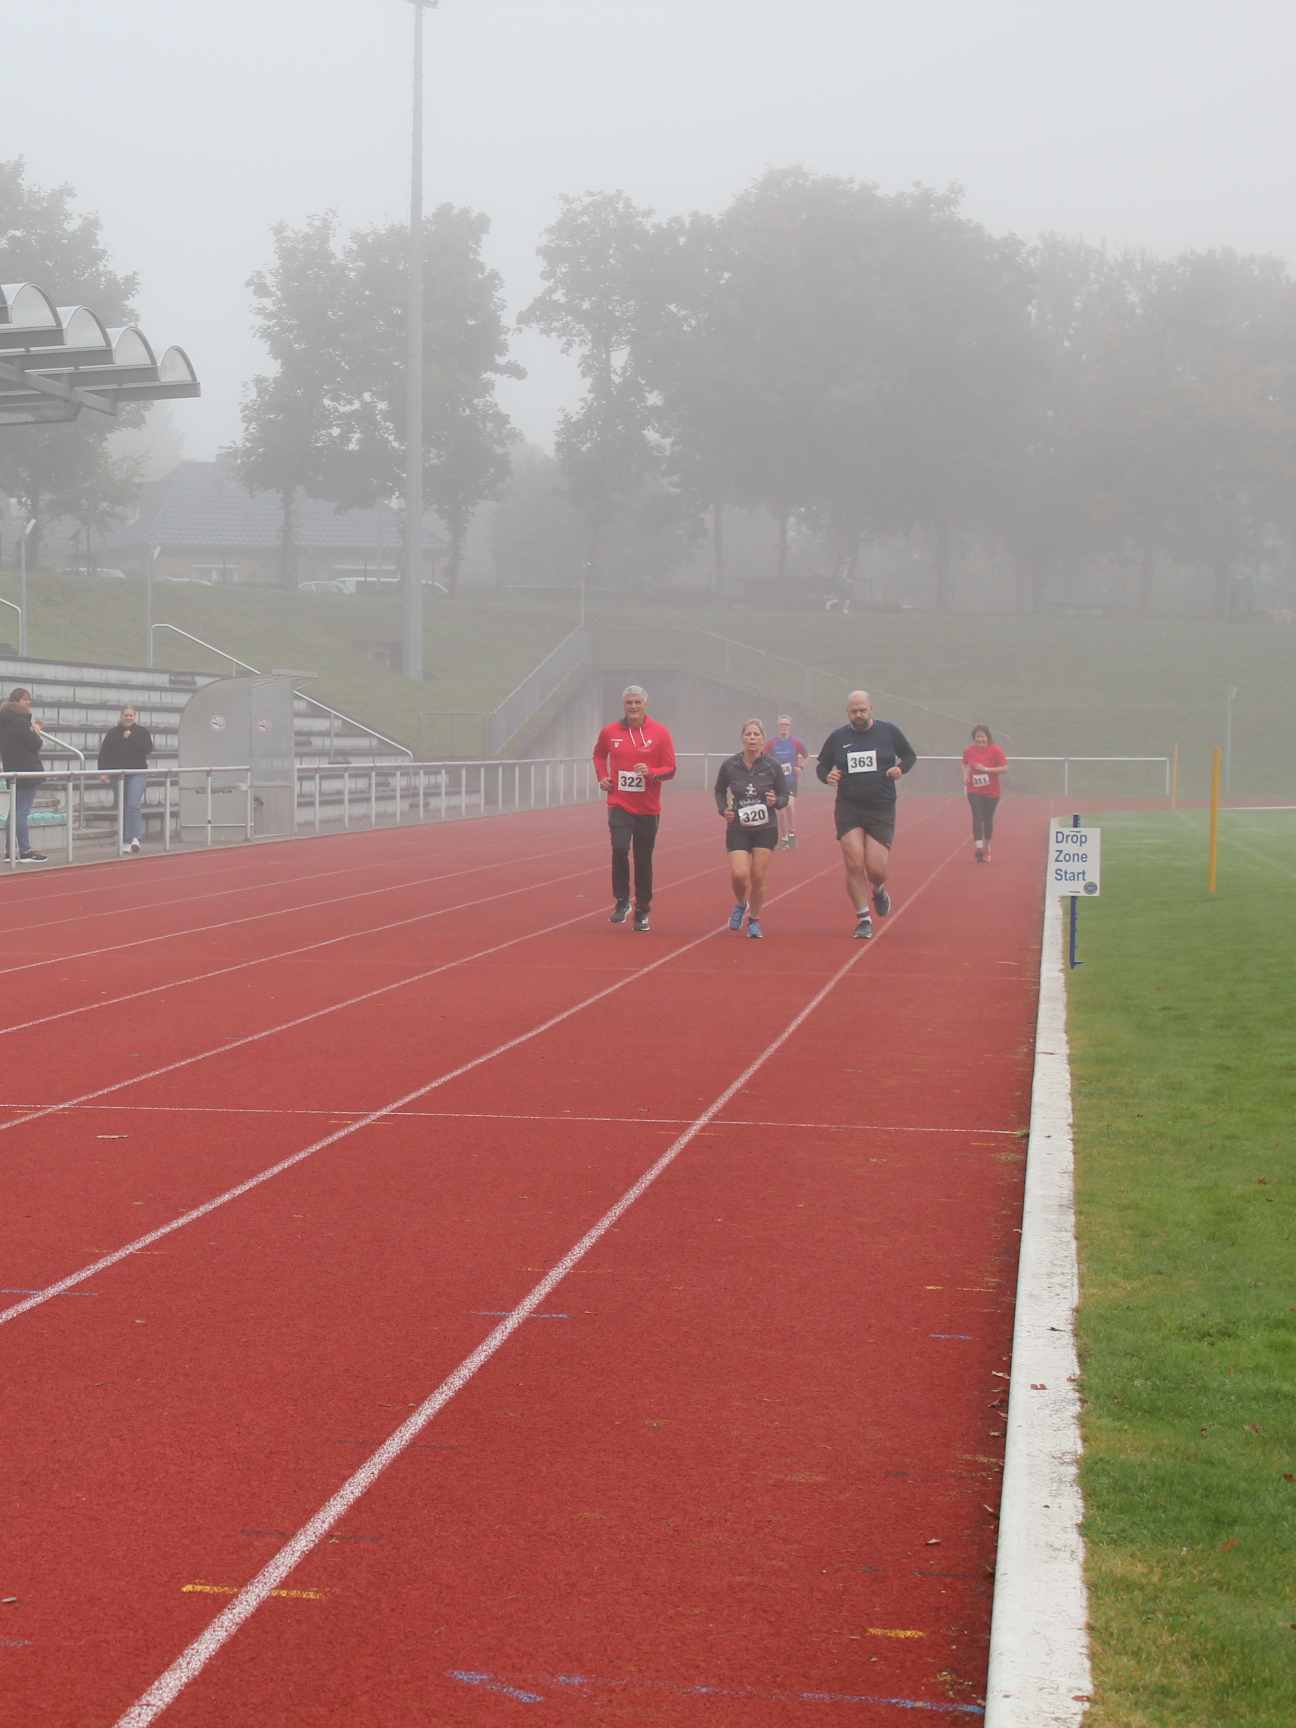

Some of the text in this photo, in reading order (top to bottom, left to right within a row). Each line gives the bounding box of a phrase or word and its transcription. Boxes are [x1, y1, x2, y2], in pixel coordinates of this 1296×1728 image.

[850, 756, 873, 768] 363
[620, 776, 643, 787] 322
[743, 809, 766, 823] 320
[1056, 831, 1088, 847] Drop
[1055, 850, 1088, 863] Zone
[1055, 868, 1086, 881] Start
